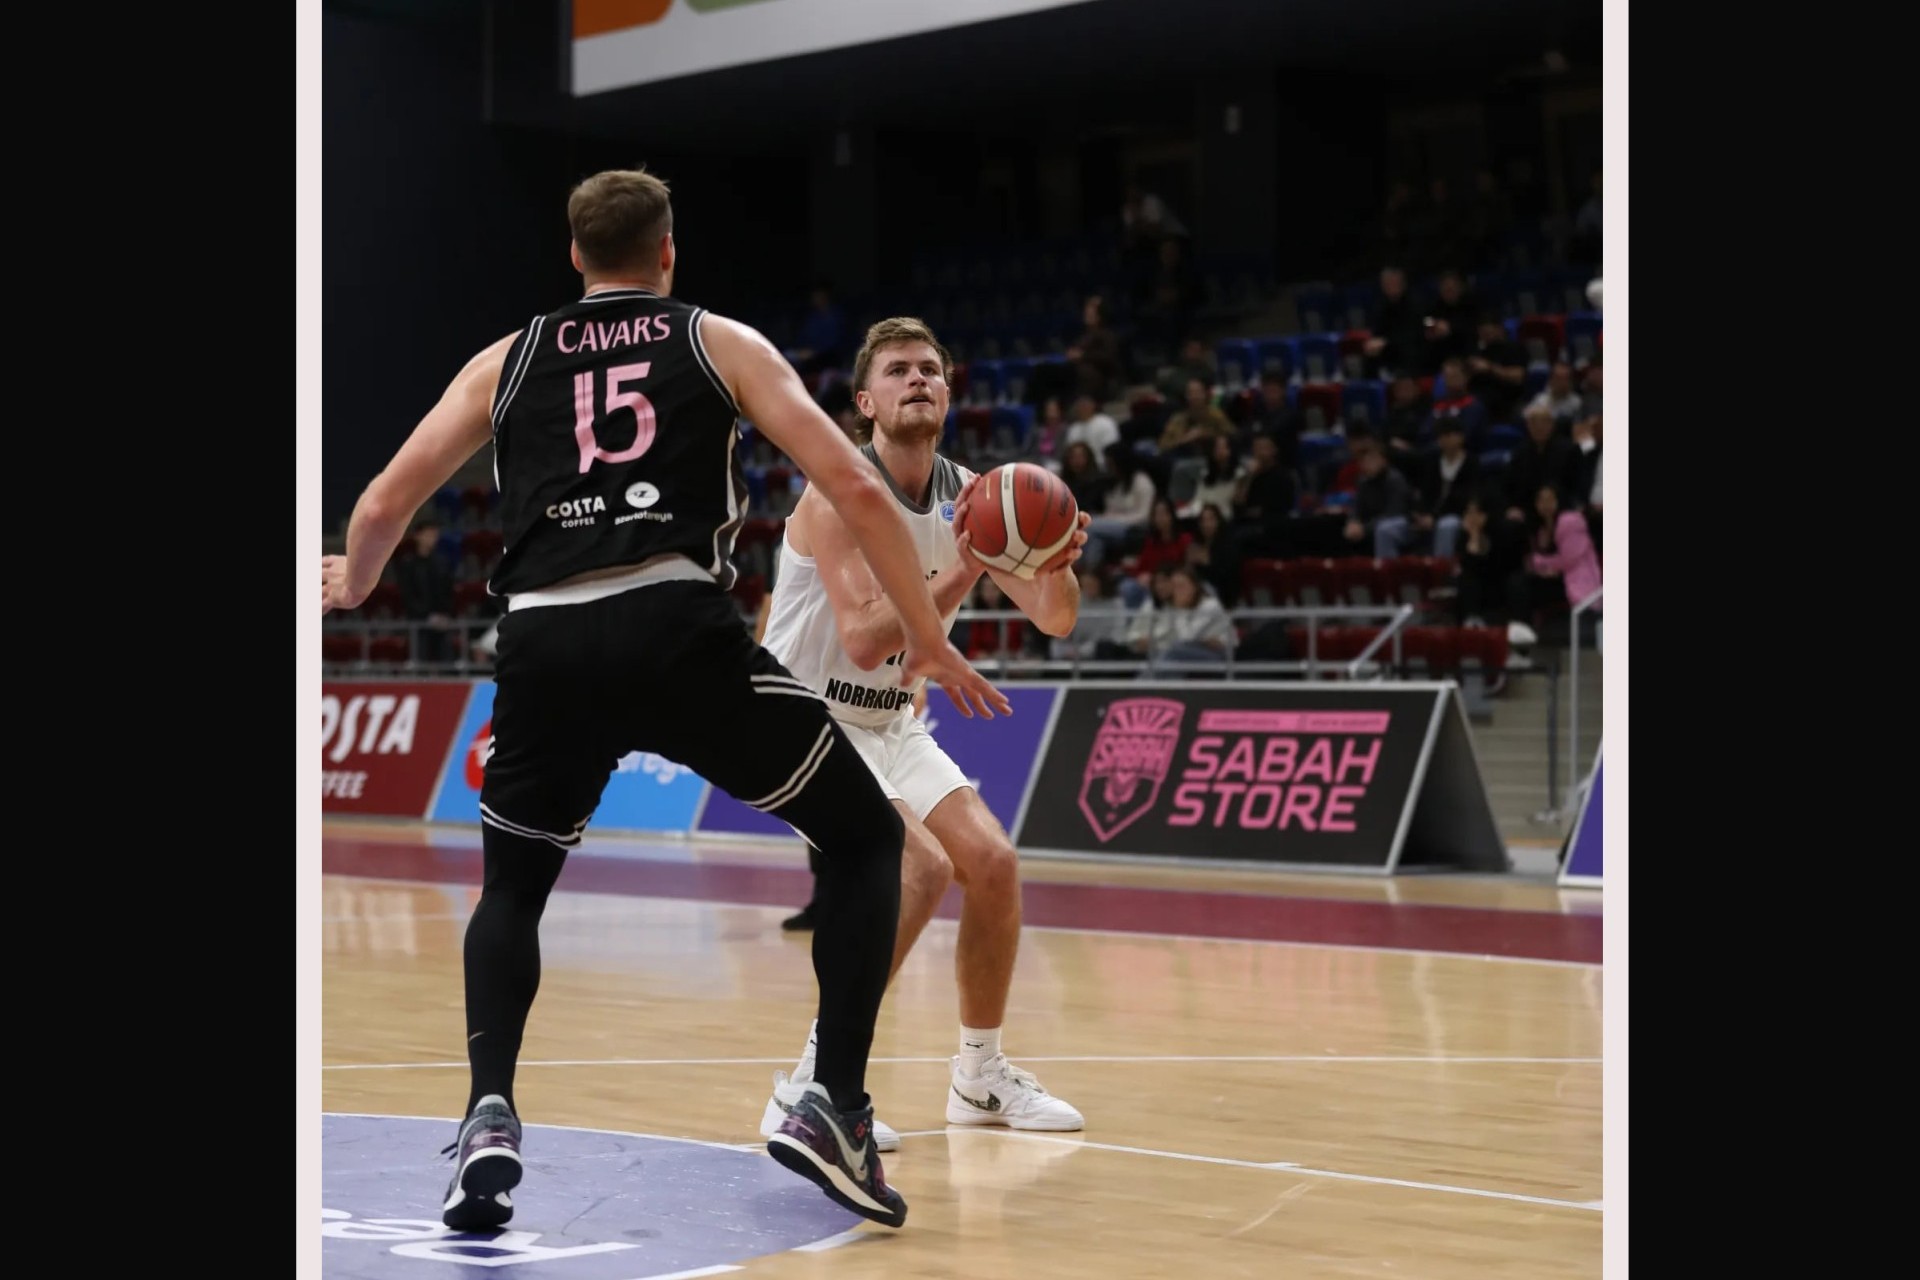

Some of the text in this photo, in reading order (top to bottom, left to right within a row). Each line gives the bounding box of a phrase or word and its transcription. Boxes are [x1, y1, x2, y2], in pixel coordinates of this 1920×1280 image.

[557, 314, 671, 354] CAVARS
[574, 362, 656, 474] 15
[546, 496, 606, 519] COSTA
[561, 517, 595, 528] COFFEE
[1183, 736, 1382, 784] SABAH
[1167, 782, 1366, 832] STORE
